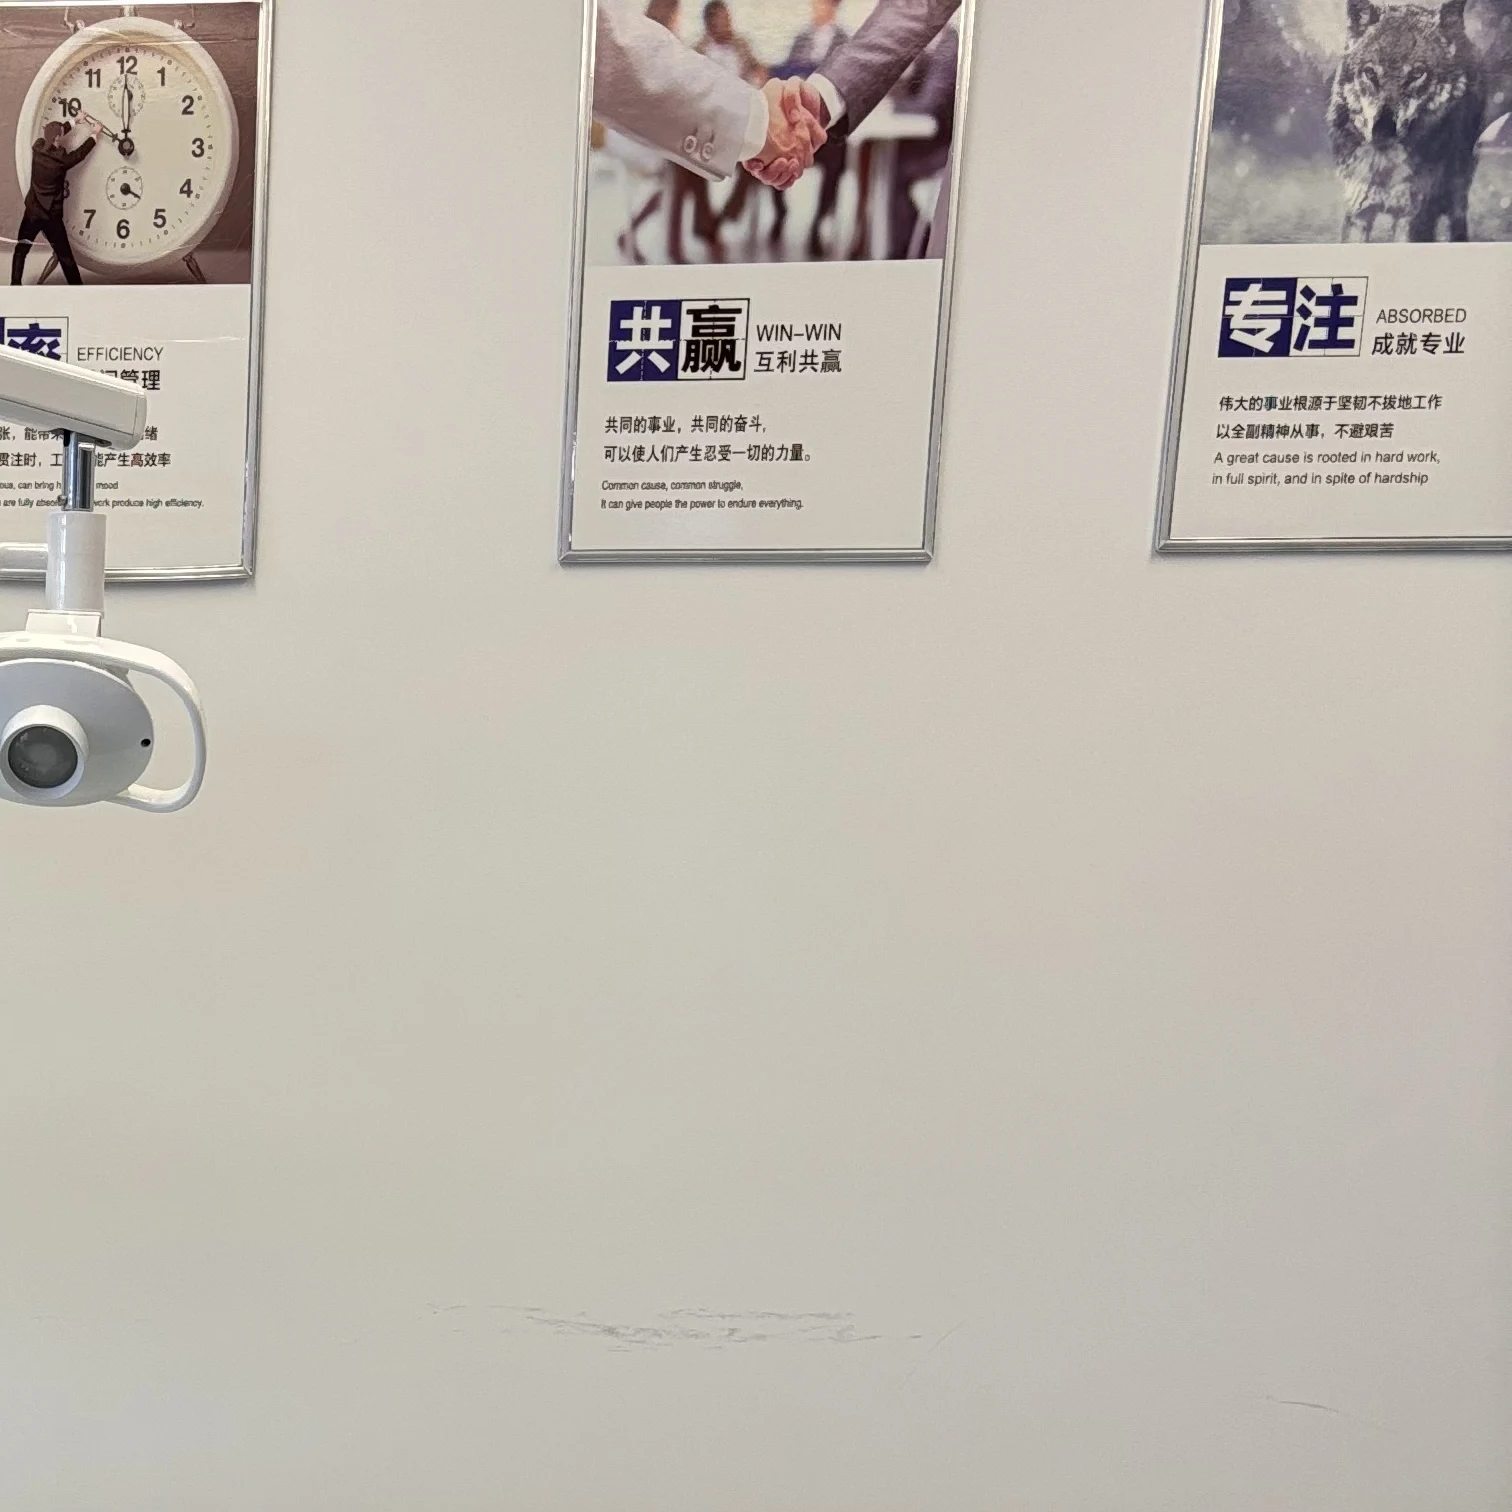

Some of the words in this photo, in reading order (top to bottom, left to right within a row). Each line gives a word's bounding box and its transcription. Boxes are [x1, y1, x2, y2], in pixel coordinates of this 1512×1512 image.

[117, 55, 138, 75] 12
[85, 68, 101, 88] 11
[157, 67, 166, 87] 1
[59, 97, 82, 118] 10
[181, 95, 195, 115] 2
[191, 137, 205, 158] 3
[179, 178, 193, 198] 4
[83, 209, 97, 229] 7
[153, 208, 167, 228] 5
[116, 219, 130, 239] 6
[1225, 283, 1359, 353] 专注
[1376, 308, 1467, 324] ABSORBED
[614, 303, 743, 375] 共赢
[756, 323, 842, 342] WIN-WIN
[77, 346, 164, 361] EFFICIENCY
[1371, 331, 1466, 356] 成就专业
[754, 350, 842, 373] 互利共赢
[1219, 394, 1443, 411] 伟大的事业根源于坚韧不拔地工作
[1213, 452, 1223, 464] A
[1226, 452, 1259, 466] great
[1262, 454, 1300, 464] cause
[1303, 451, 1314, 463] is
[1317, 451, 1357, 463] rooted
[1360, 451, 1371, 463] in
[1375, 450, 1404, 463] hard
[1406, 450, 1440, 464] work,
[34, 481, 54, 491] bring
[601, 480, 639, 490] Common
[641, 482, 668, 491] cause,
[670, 481, 706, 490] common
[1211, 473, 1223, 484] in
[1225, 472, 1244, 484] full
[1247, 472, 1281, 486] spirit,
[1284, 472, 1308, 484] and
[1311, 472, 1322, 484] in
[1325, 472, 1355, 486] spite
[1358, 471, 1372, 484] of
[1374, 472, 1429, 486] hardship
[146, 498, 163, 509] high
[608, 500, 623, 508] can
[625, 499, 642, 510] give
[644, 499, 672, 510] people
[674, 499, 688, 508] the
[689, 500, 716, 510] power
[717, 499, 725, 508] to
[727, 498, 756, 508] endure
